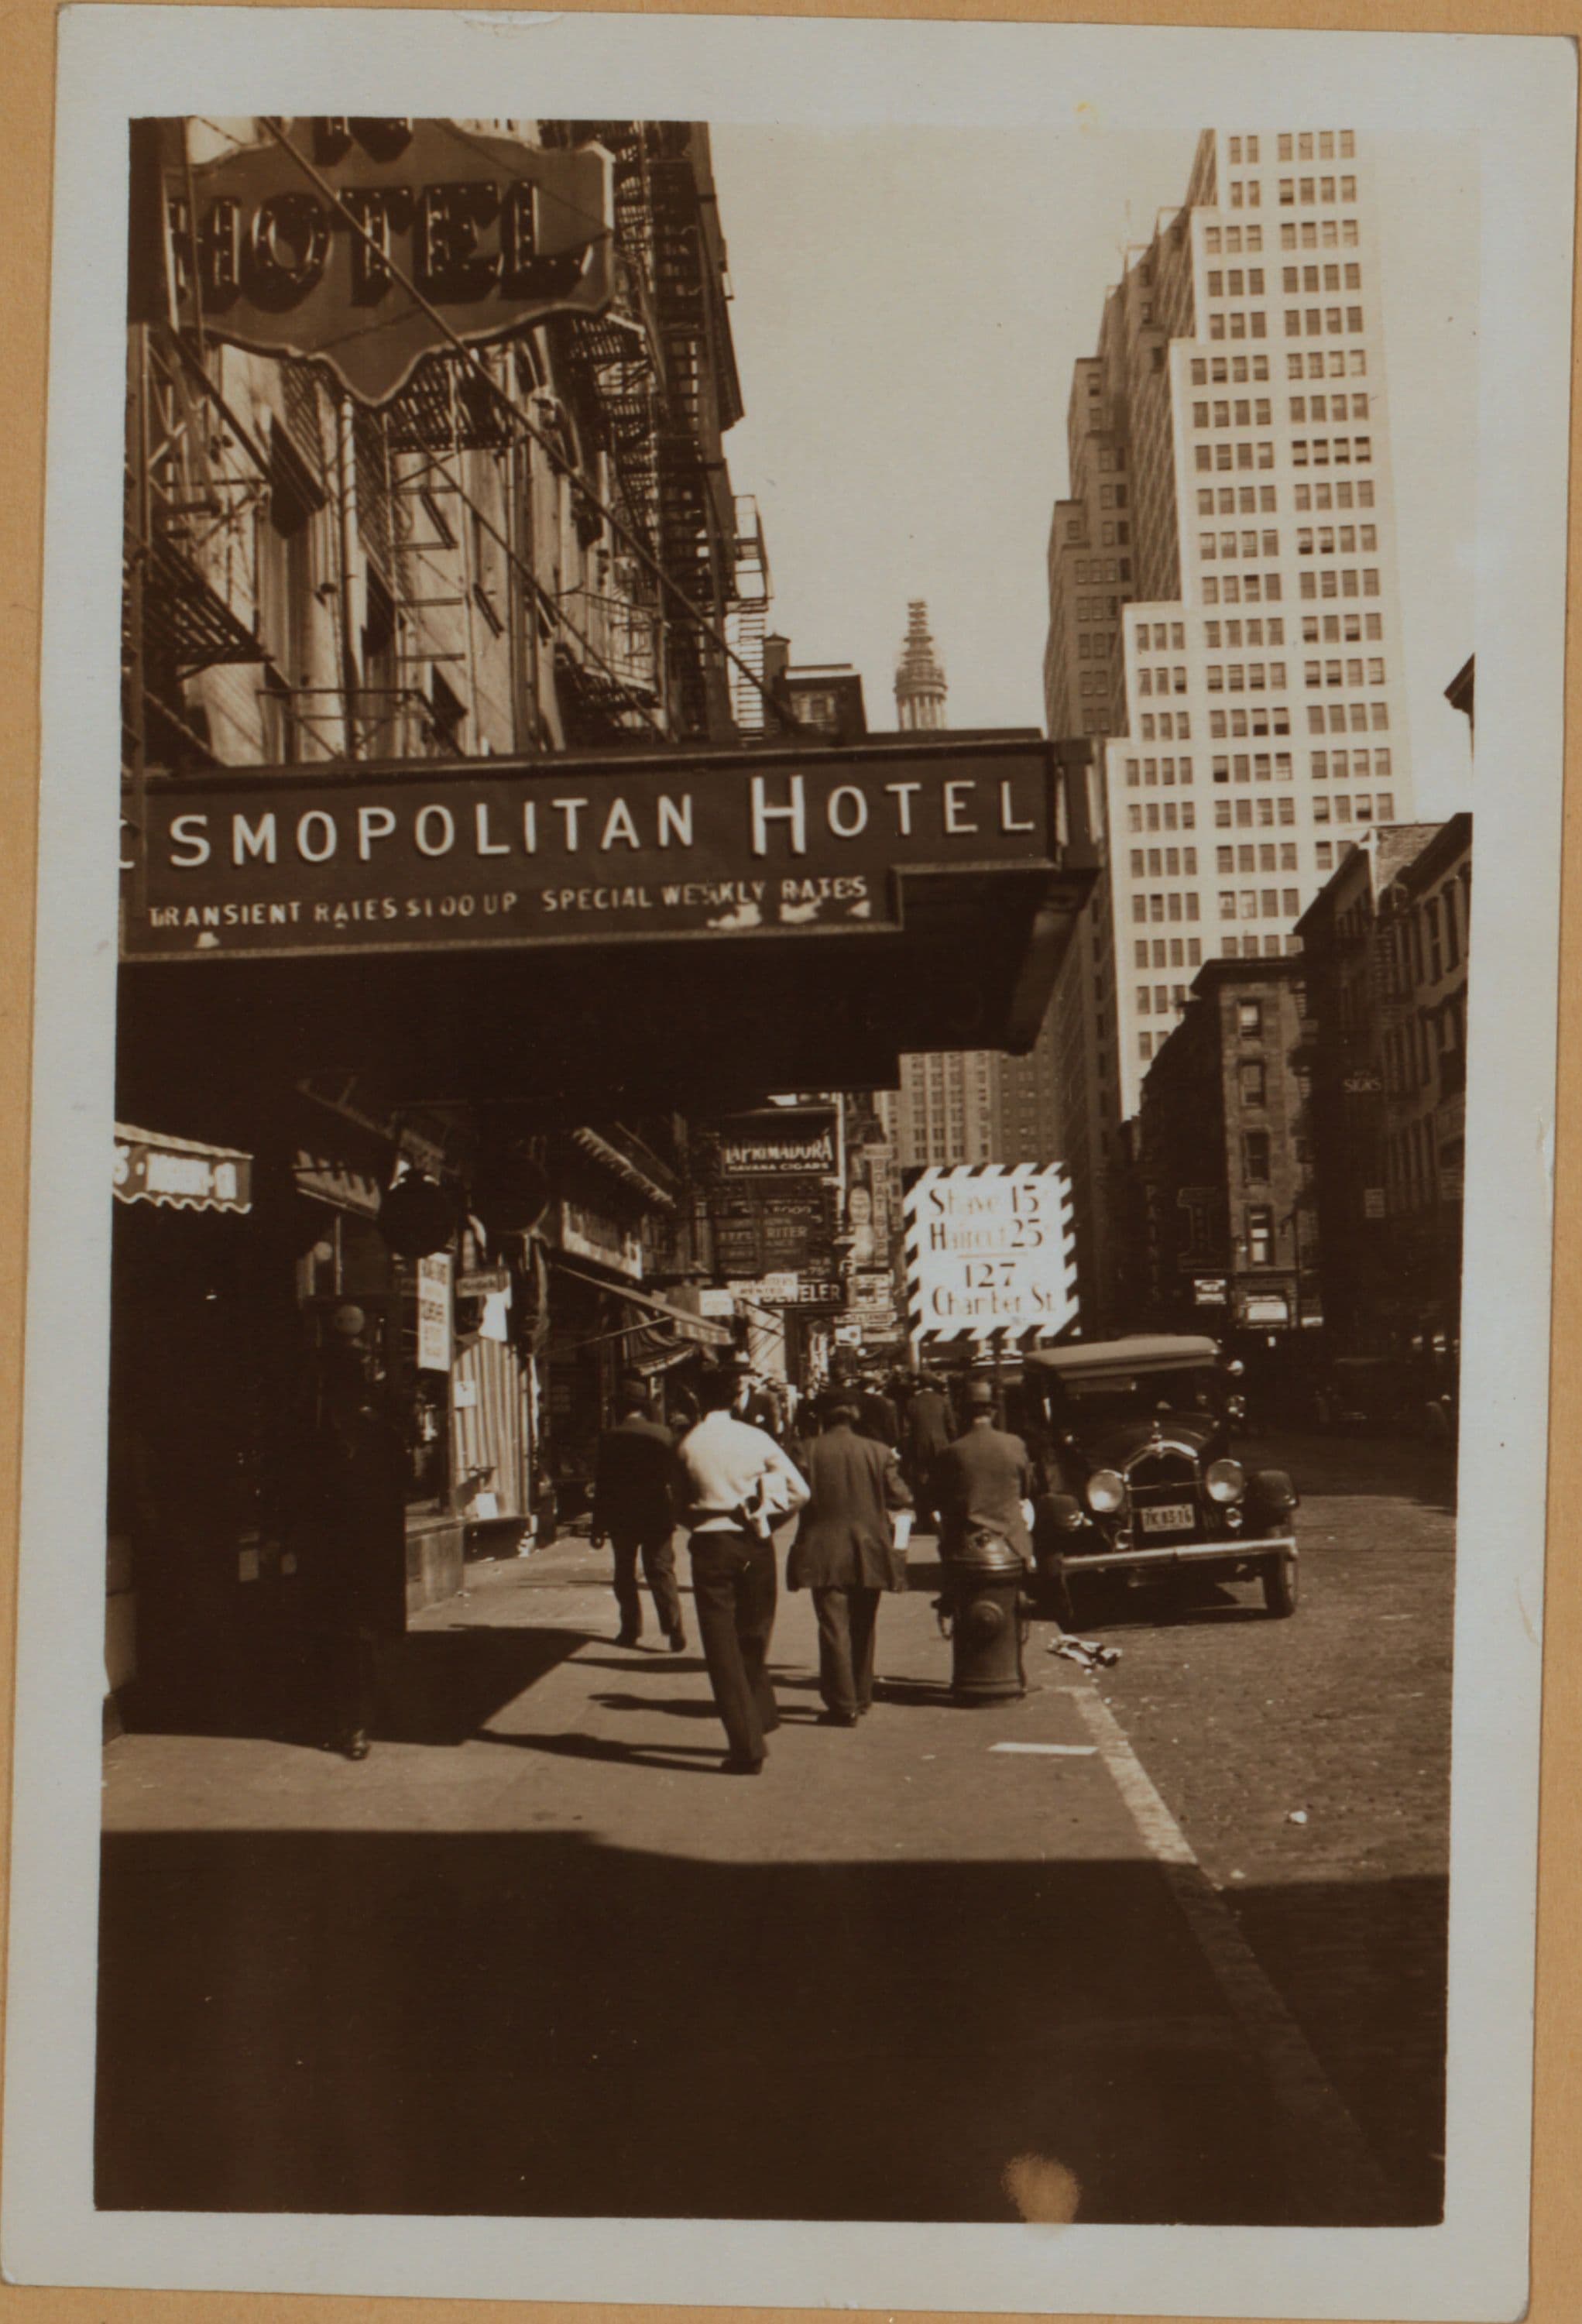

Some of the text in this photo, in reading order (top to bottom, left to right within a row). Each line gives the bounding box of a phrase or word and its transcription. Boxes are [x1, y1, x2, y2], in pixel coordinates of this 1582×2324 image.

[167, 180, 590, 313] HOTEL
[120, 774, 1035, 869] SMOPOLITAN HOTEL
[148, 900, 302, 928] TRANSIENT
[483, 890, 517, 915] UP
[541, 886, 653, 911] SPECIAL
[1011, 1183, 1040, 1213] 15
[1010, 1217, 1044, 1248] 25
[964, 1262, 1017, 1289] 127
